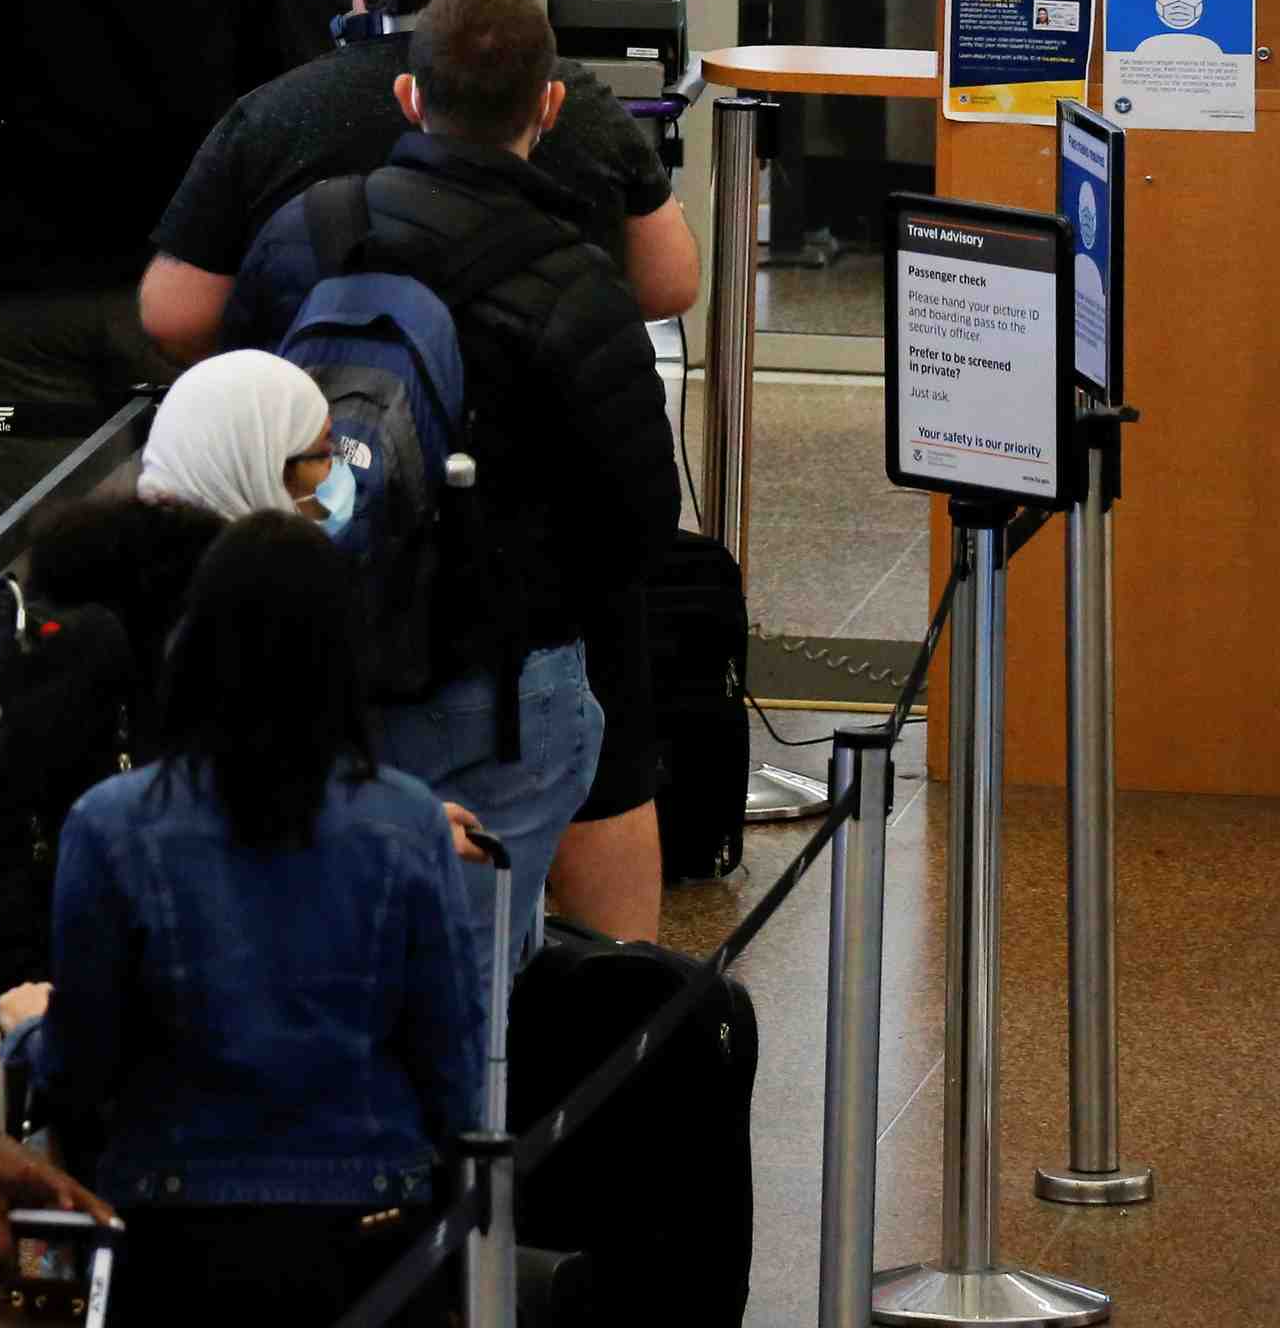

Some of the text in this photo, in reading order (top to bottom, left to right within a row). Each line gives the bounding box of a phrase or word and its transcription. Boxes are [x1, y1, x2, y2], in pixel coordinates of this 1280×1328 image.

[908, 224, 984, 248] Travel Advisory
[908, 265, 986, 287] Passenger check
[908, 290, 1040, 320] Please hand your picture ID
[908, 306, 1026, 334] and boarding pass to the
[908, 321, 948, 336] security
[909, 345, 1011, 372] Prefer to be screened
[909, 362, 961, 379] in private?
[910, 386, 929, 399] Just
[918, 426, 1041, 458] Your safety is our priority
